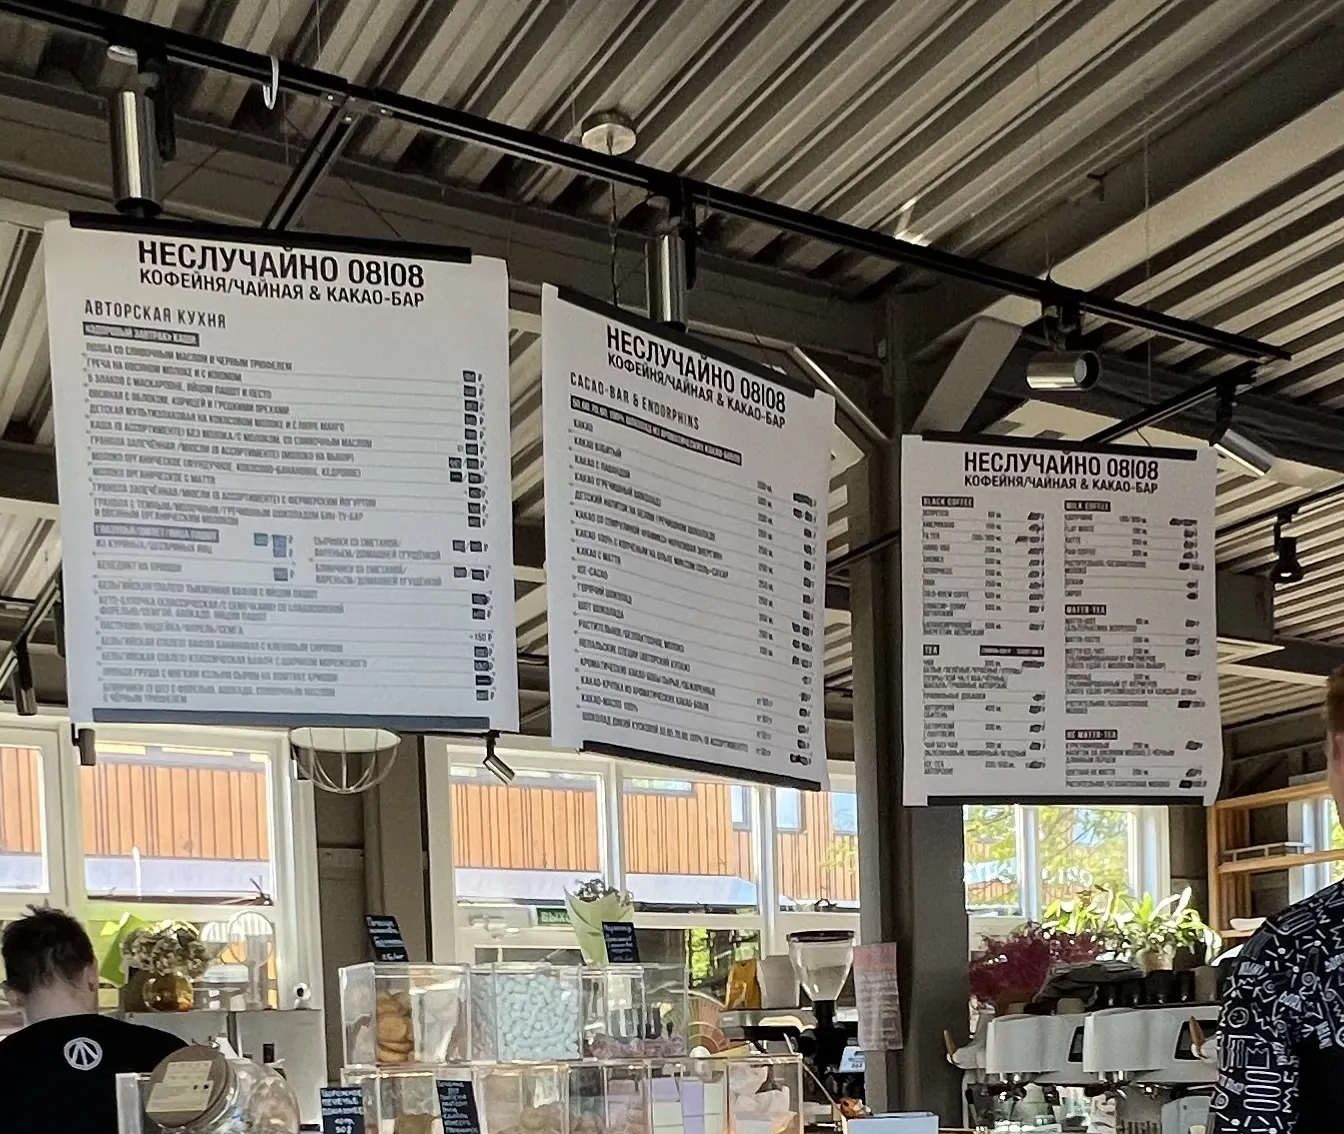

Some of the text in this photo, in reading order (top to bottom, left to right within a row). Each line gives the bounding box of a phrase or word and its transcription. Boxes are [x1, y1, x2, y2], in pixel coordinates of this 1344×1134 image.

[139, 240, 339, 283] НЕСЛУЧАЙНО
[140, 269, 424, 308] КОФЕЙНЯ/ЧАЙНАЯ & КАКАО-БАР
[85, 299, 226, 329] АВТОРСКАЯ КУХНЯ
[607, 325, 735, 393] НЕСЛУЧАЙНО
[608, 353, 785, 429] КОФЕЙНЯ/ЧАЙНАЯ & КАКАО-БАР
[643, 396, 699, 430] ENDORPHINS
[964, 452, 1100, 475] НЕСЛУЧАЙНО
[964, 474, 1158, 494] КОФЕЙНЯ/ЧАЙНАЯ & КАКАО-БАР
